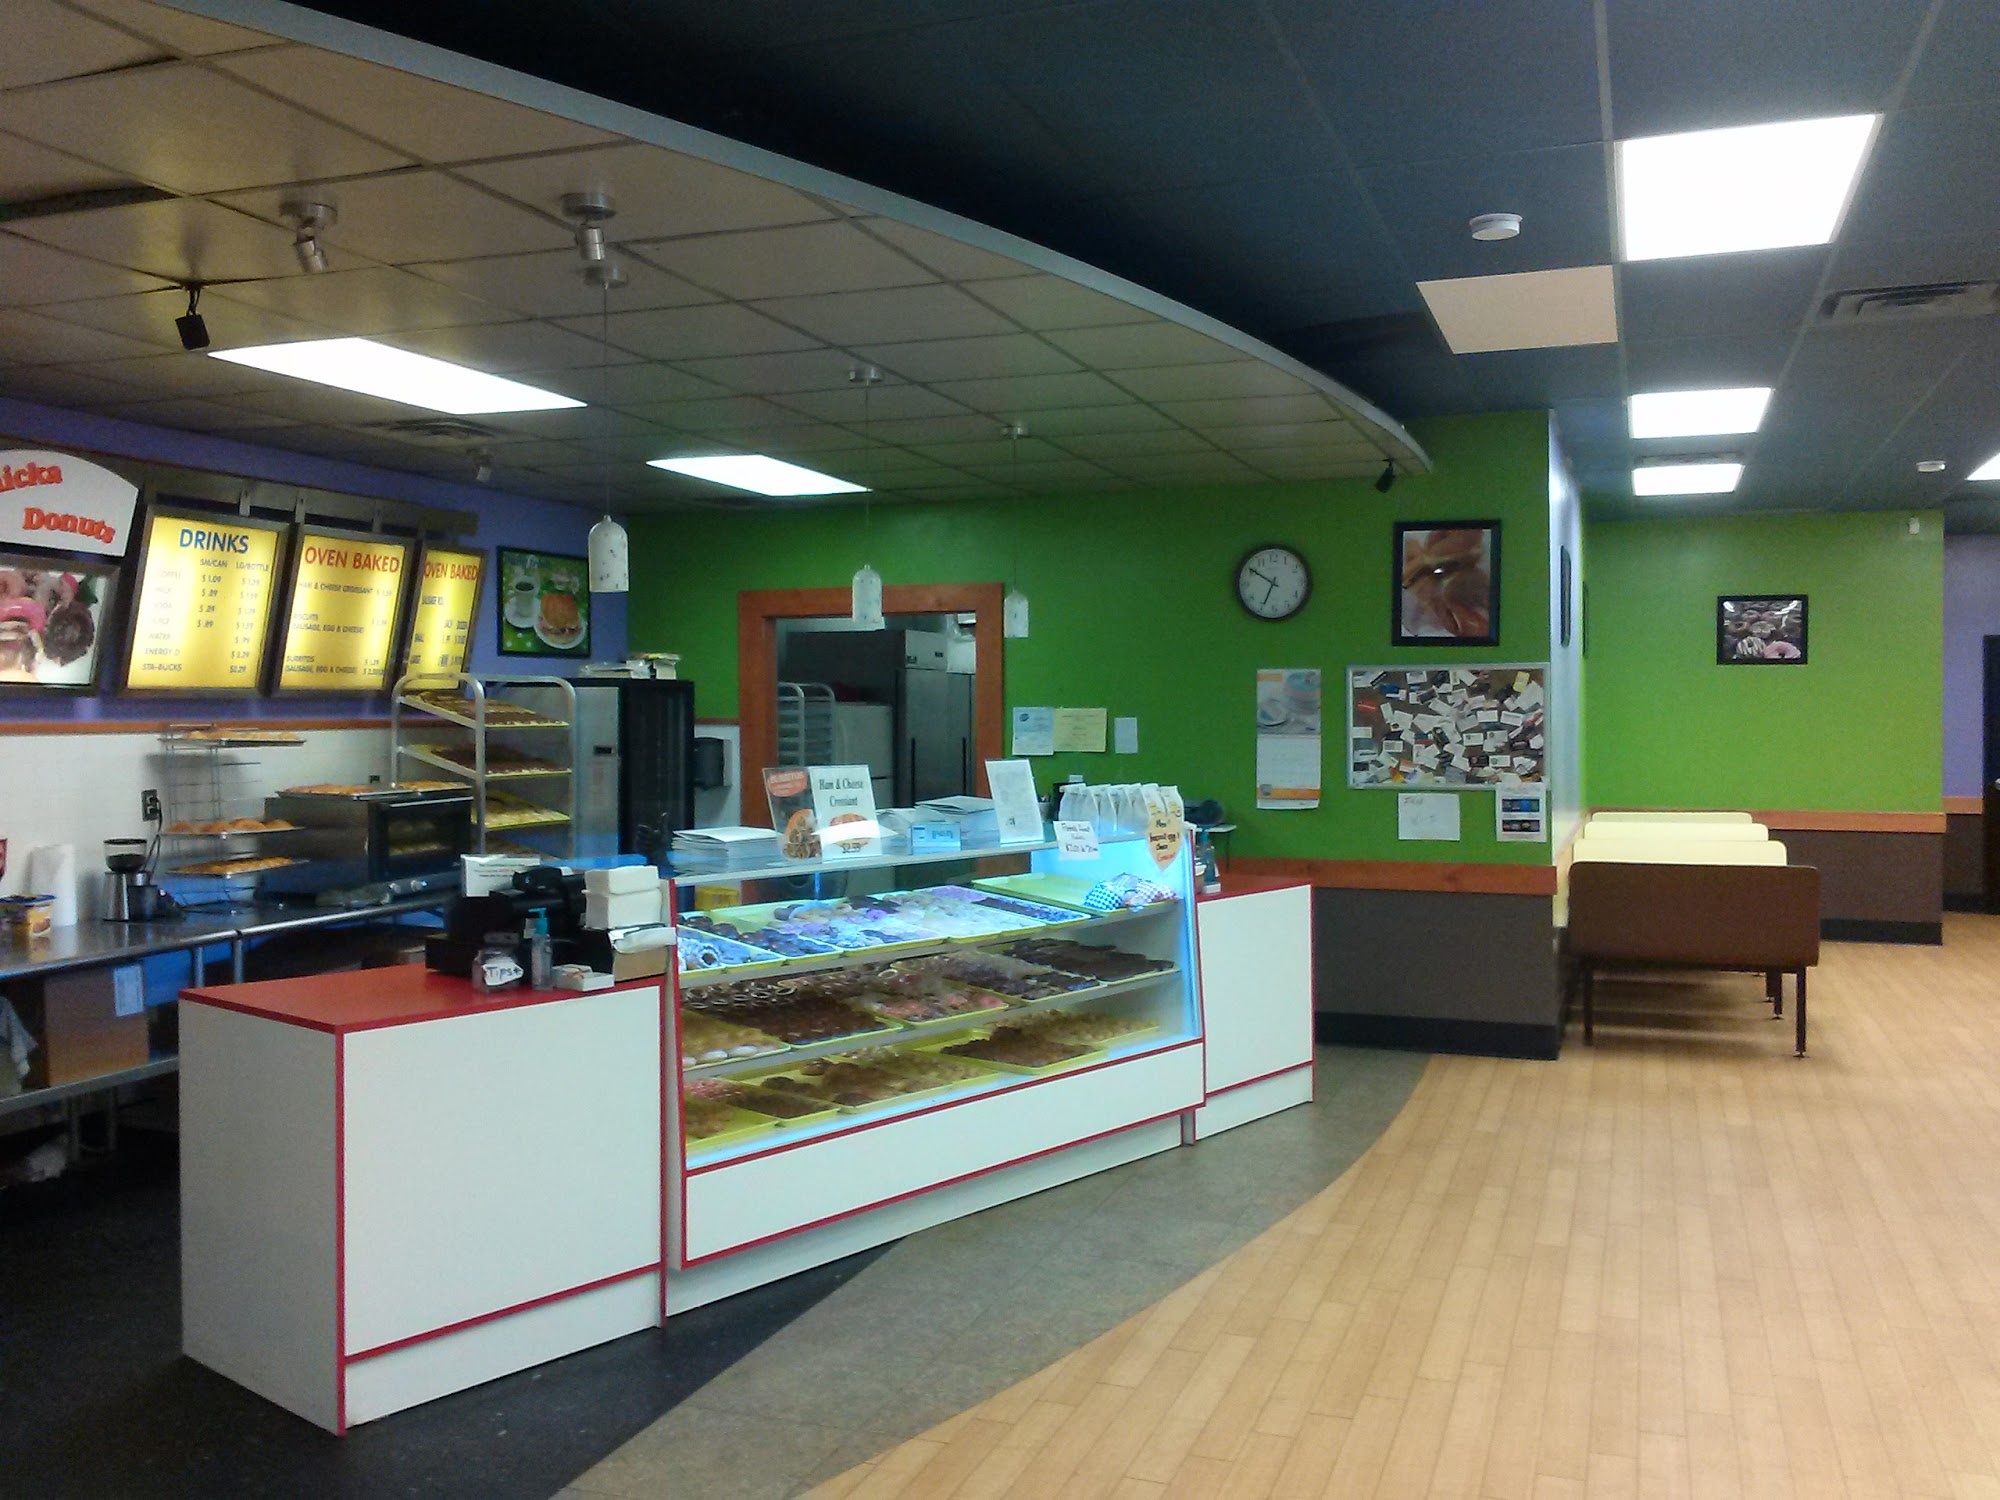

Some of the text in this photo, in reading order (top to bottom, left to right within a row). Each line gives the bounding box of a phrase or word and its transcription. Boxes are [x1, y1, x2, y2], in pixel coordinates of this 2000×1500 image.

[0, 462, 63, 493] icka
[23, 507, 116, 544] Donuts
[179, 528, 249, 554] DRINKS
[305, 546, 400, 573] OVEN BAKED
[423, 561, 480, 581] OVEN BAKED
[819, 779, 834, 790] Ham
[836, 778, 841, 790] &
